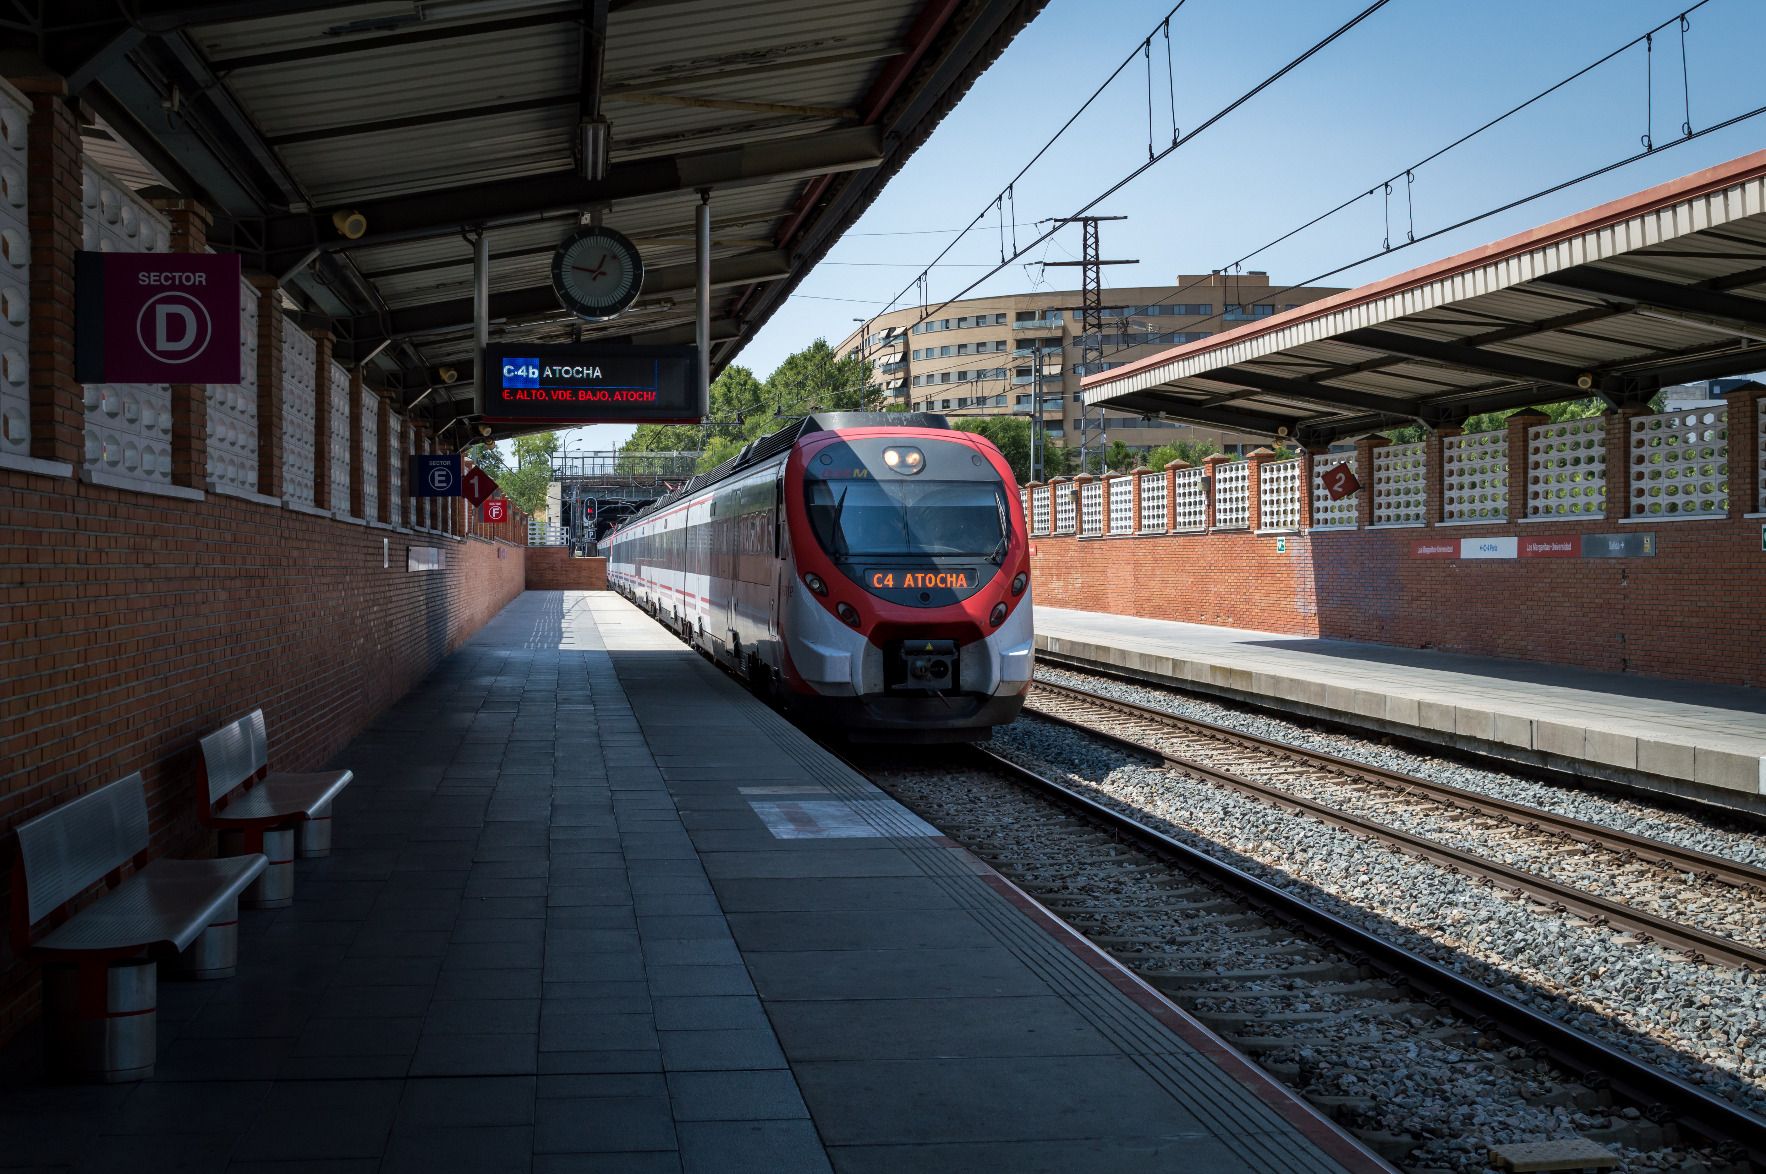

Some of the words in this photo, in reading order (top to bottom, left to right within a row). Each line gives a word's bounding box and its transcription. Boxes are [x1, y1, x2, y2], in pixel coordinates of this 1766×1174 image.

[138, 271, 207, 286] SECTOR
[155, 303, 198, 351] D
[543, 366, 602, 379] ATOCHA
[434, 470, 448, 487] E
[469, 475, 480, 498] 1
[1332, 472, 1347, 492] 2
[493, 507, 499, 518] F
[872, 573, 895, 588] C4
[903, 573, 968, 588] ATOCHA
